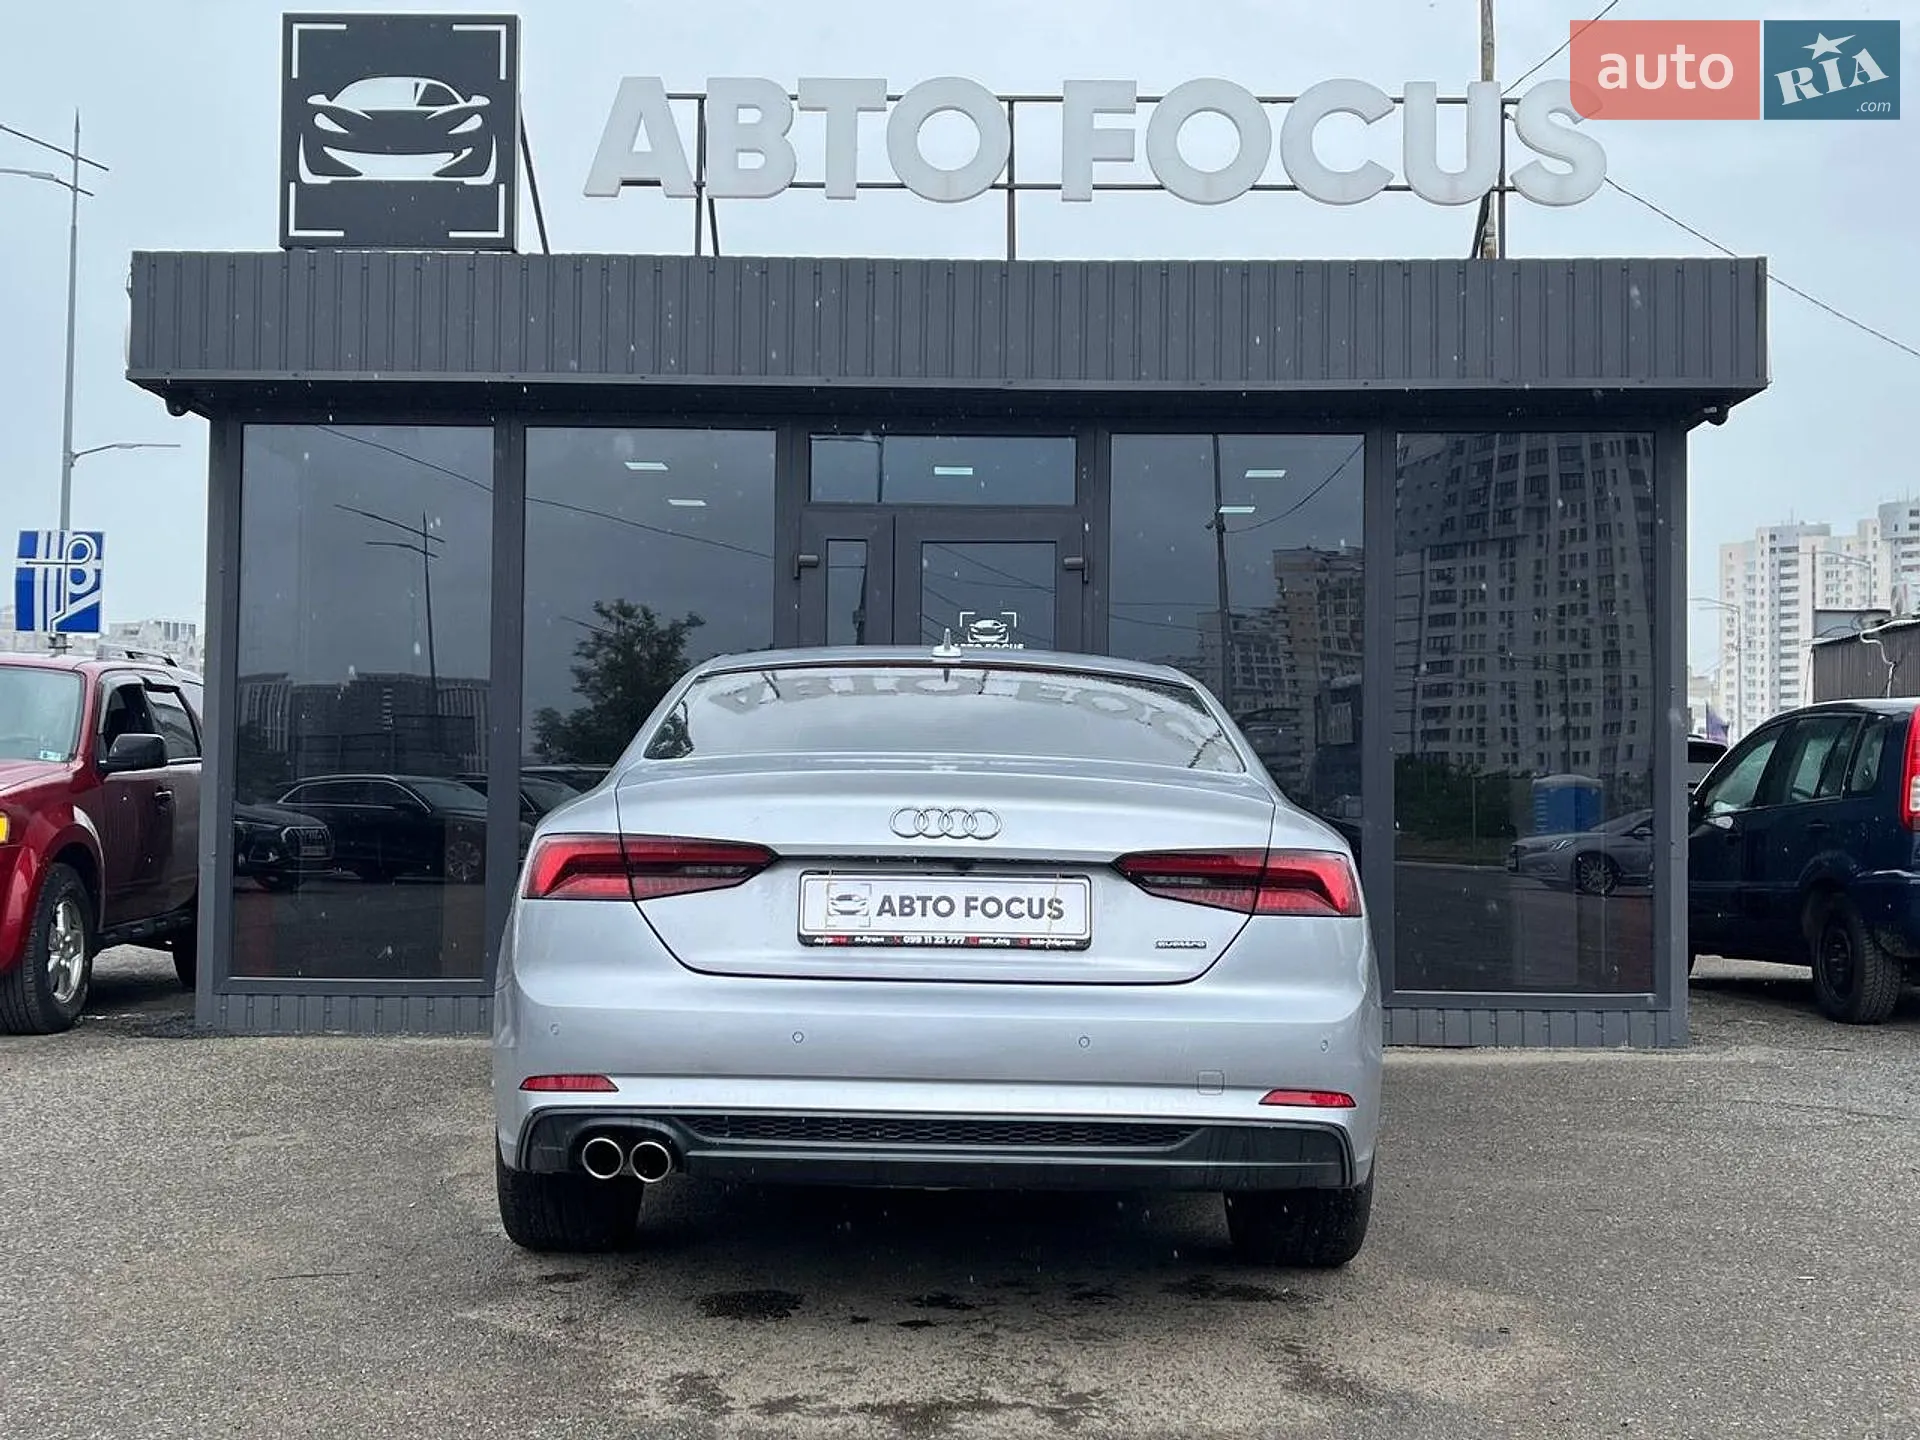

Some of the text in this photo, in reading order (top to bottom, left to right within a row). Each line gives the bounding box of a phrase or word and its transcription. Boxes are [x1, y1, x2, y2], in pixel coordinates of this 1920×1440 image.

[584, 76, 1607, 206] АВТО FOCUS
[876, 895, 1065, 920] АВТО FOCUS
